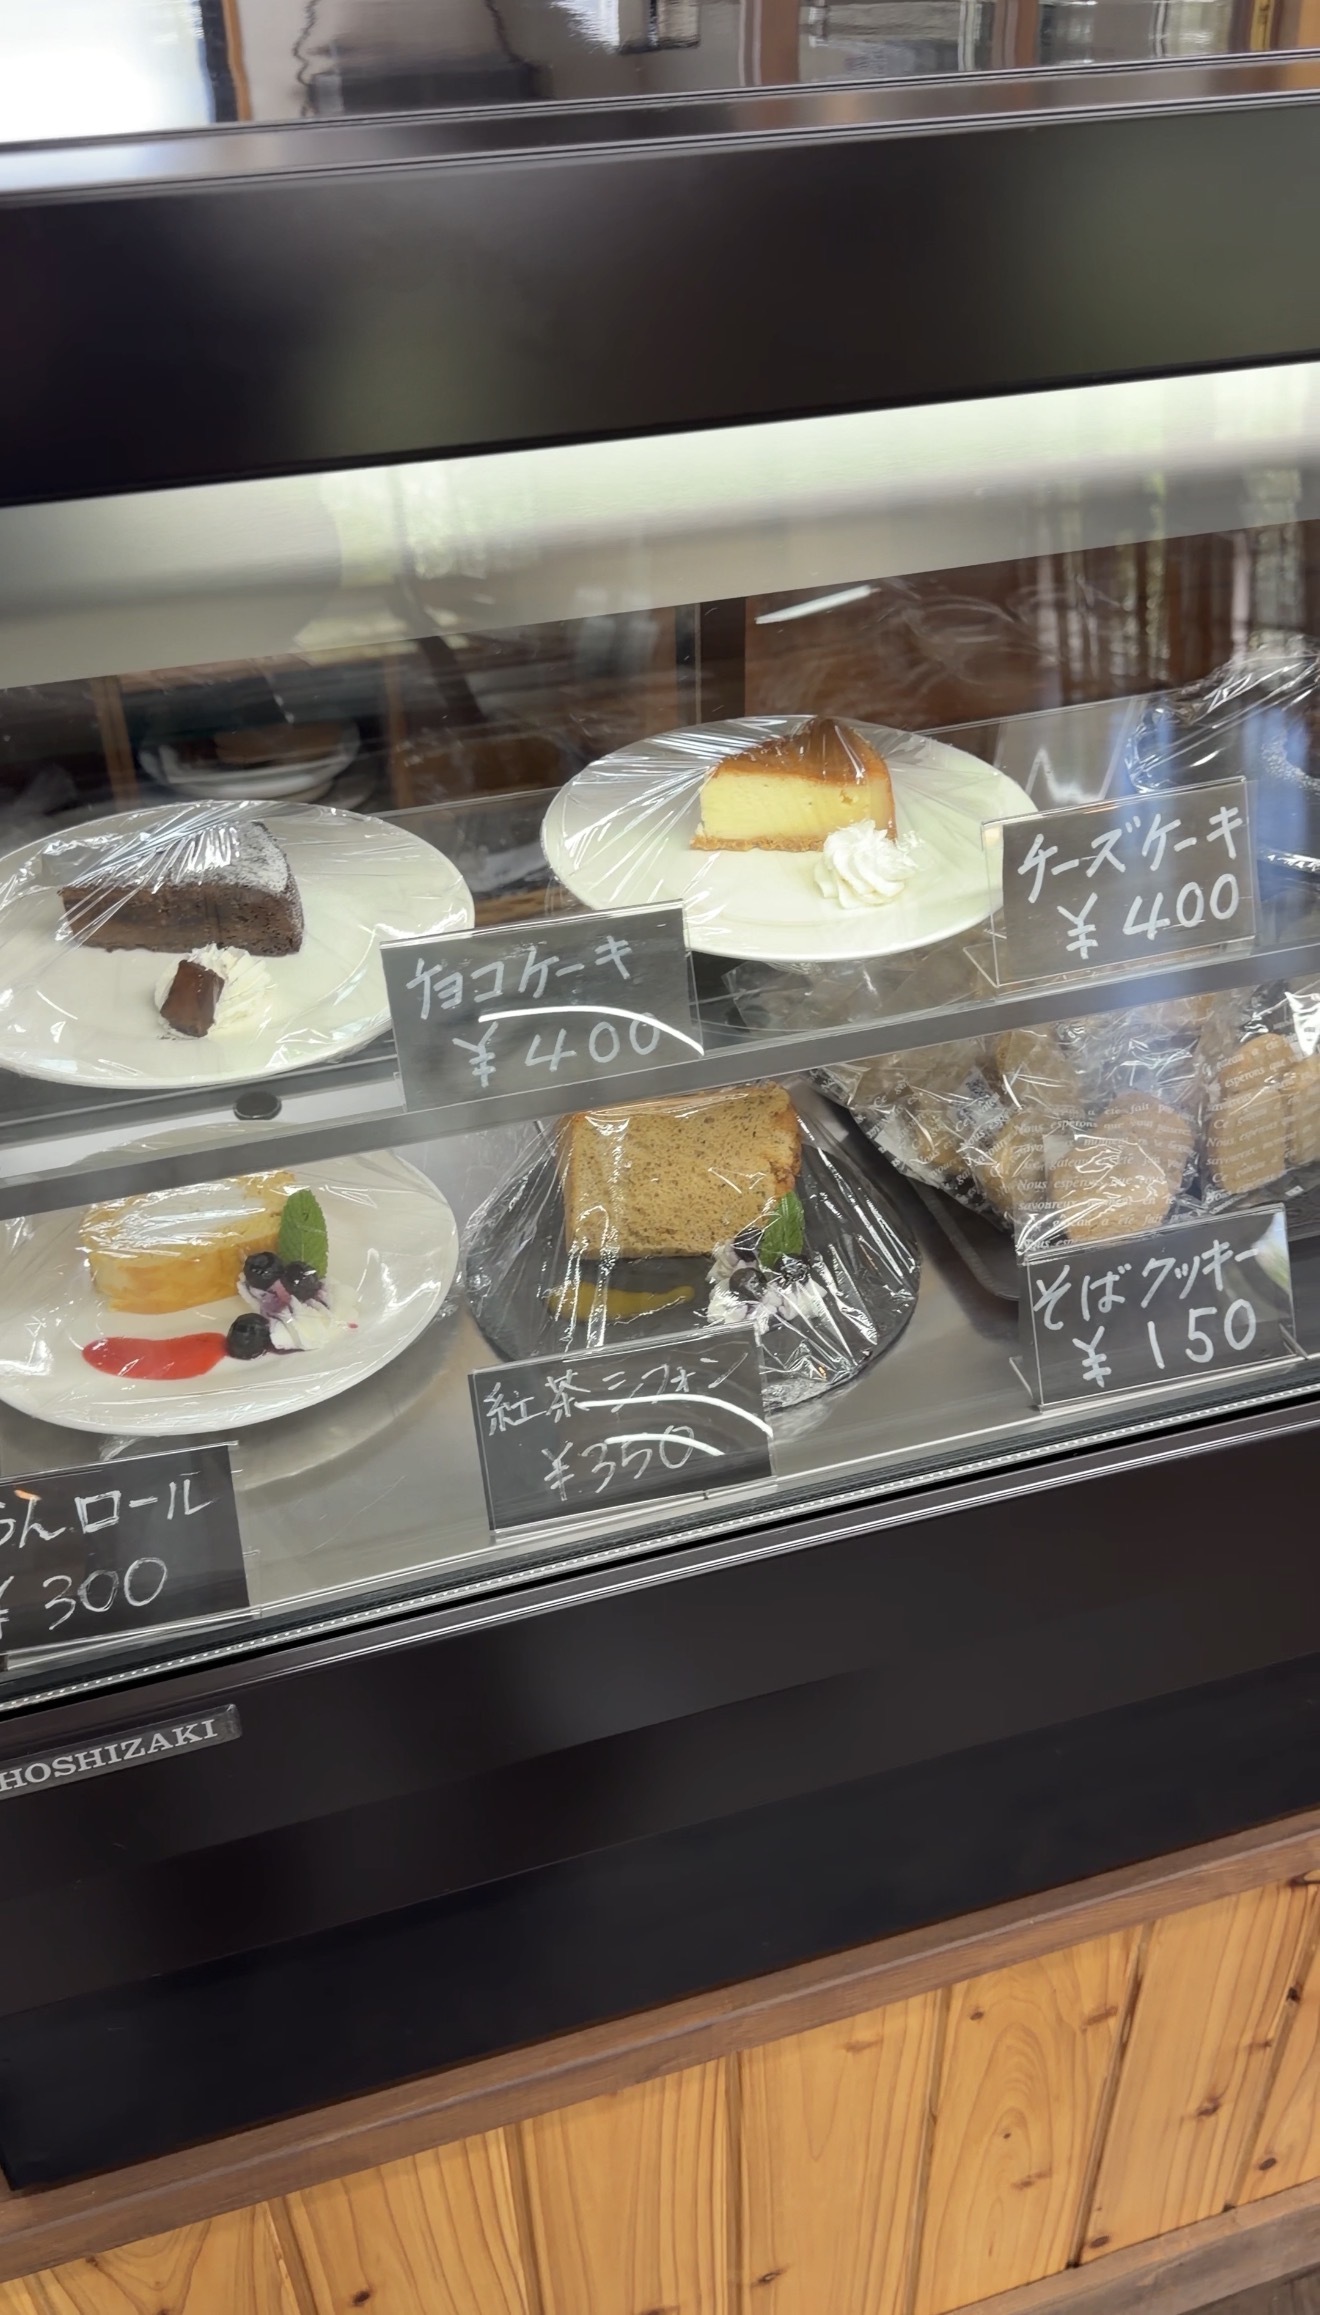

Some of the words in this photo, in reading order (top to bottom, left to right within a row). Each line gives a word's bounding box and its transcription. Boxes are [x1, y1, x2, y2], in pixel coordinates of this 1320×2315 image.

[1017, 806, 1243, 904] チーズケーキ
[405, 934, 633, 1020] チョコケーキ
[1017, 1179, 1048, 1191] Nous
[1032, 1239, 1260, 1331] そばクッキー
[0, 1719, 218, 1792] HOSHIZAKI
